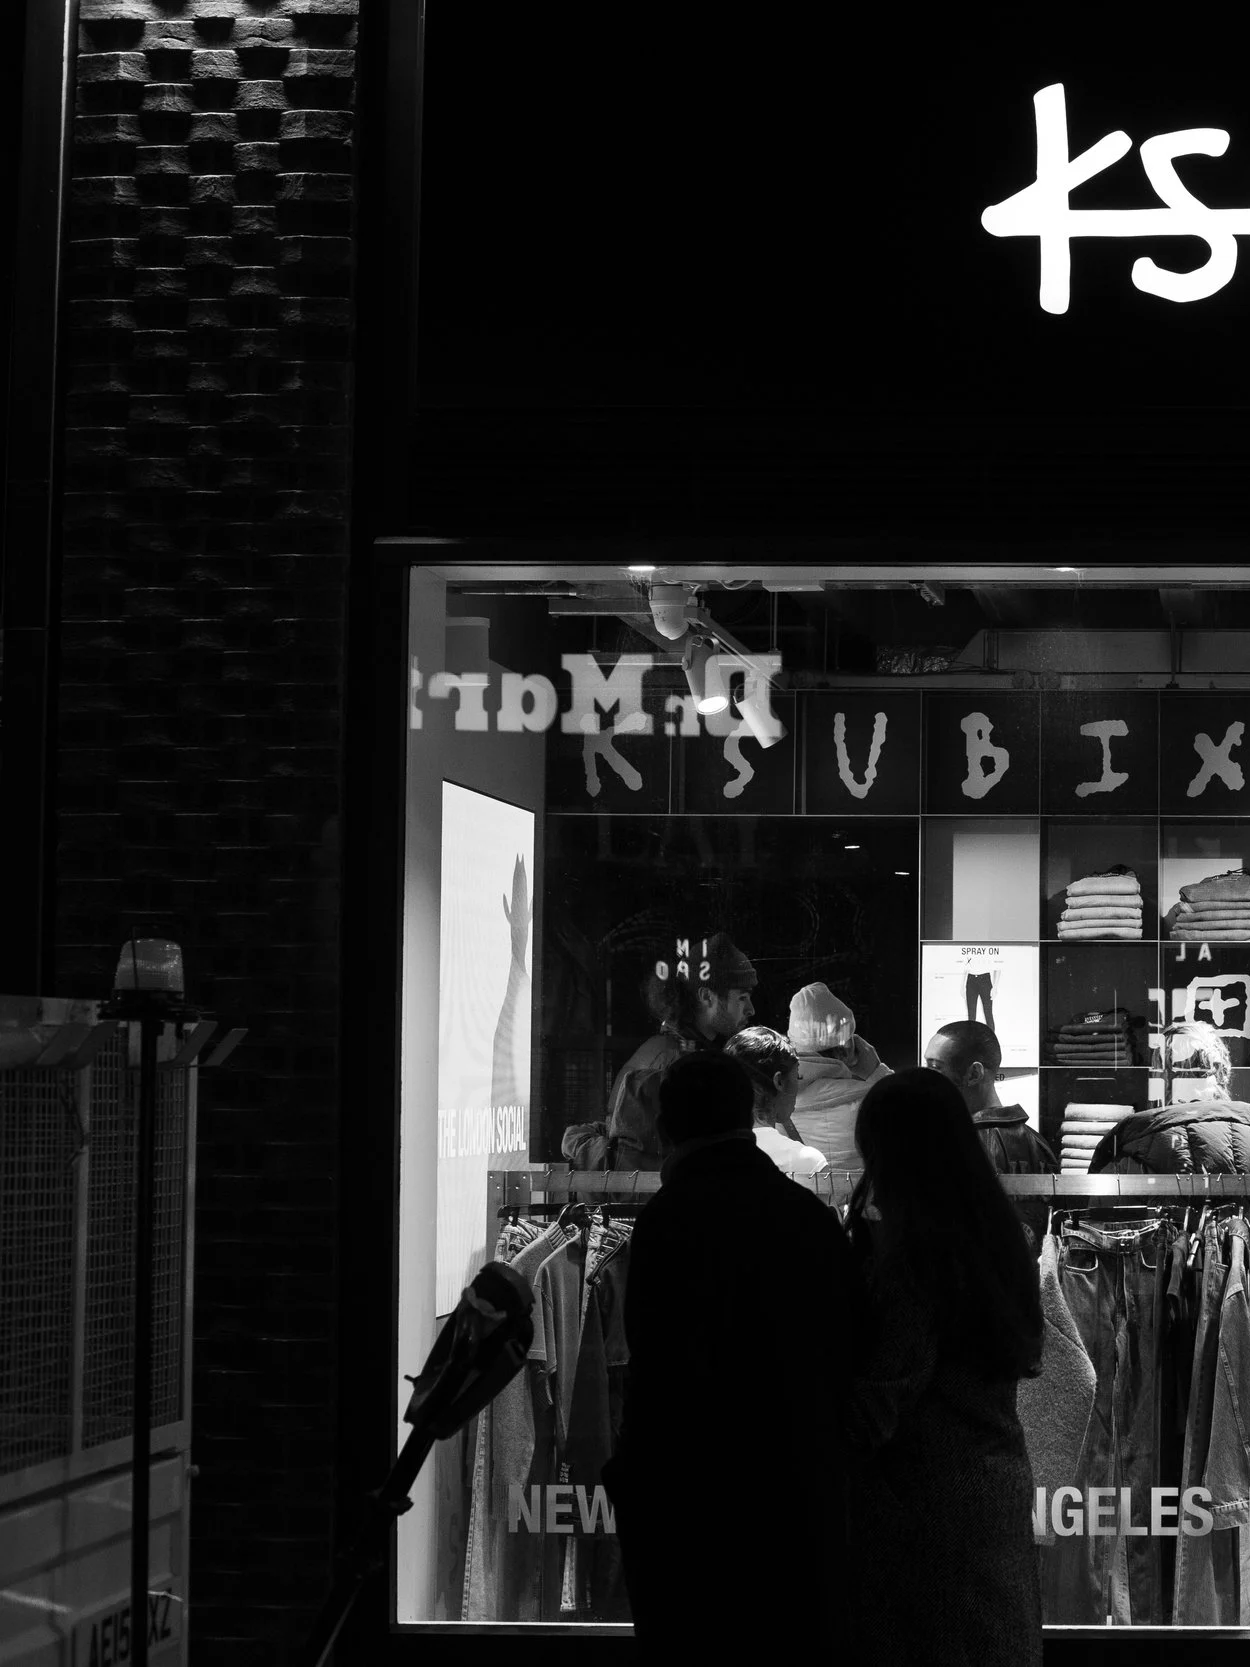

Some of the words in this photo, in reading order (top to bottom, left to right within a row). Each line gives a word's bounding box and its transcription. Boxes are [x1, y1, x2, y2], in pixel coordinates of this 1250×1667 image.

[961, 947, 986, 955] SPRAY
[988, 947, 1000, 955] ON
[438, 1108, 457, 1159] THE
[458, 1107, 496, 1157] LONDON
[496, 1105, 527, 1154] SOCIAL
[508, 1484, 617, 1534] NEW
[1032, 1486, 1213, 1537] NGELES
